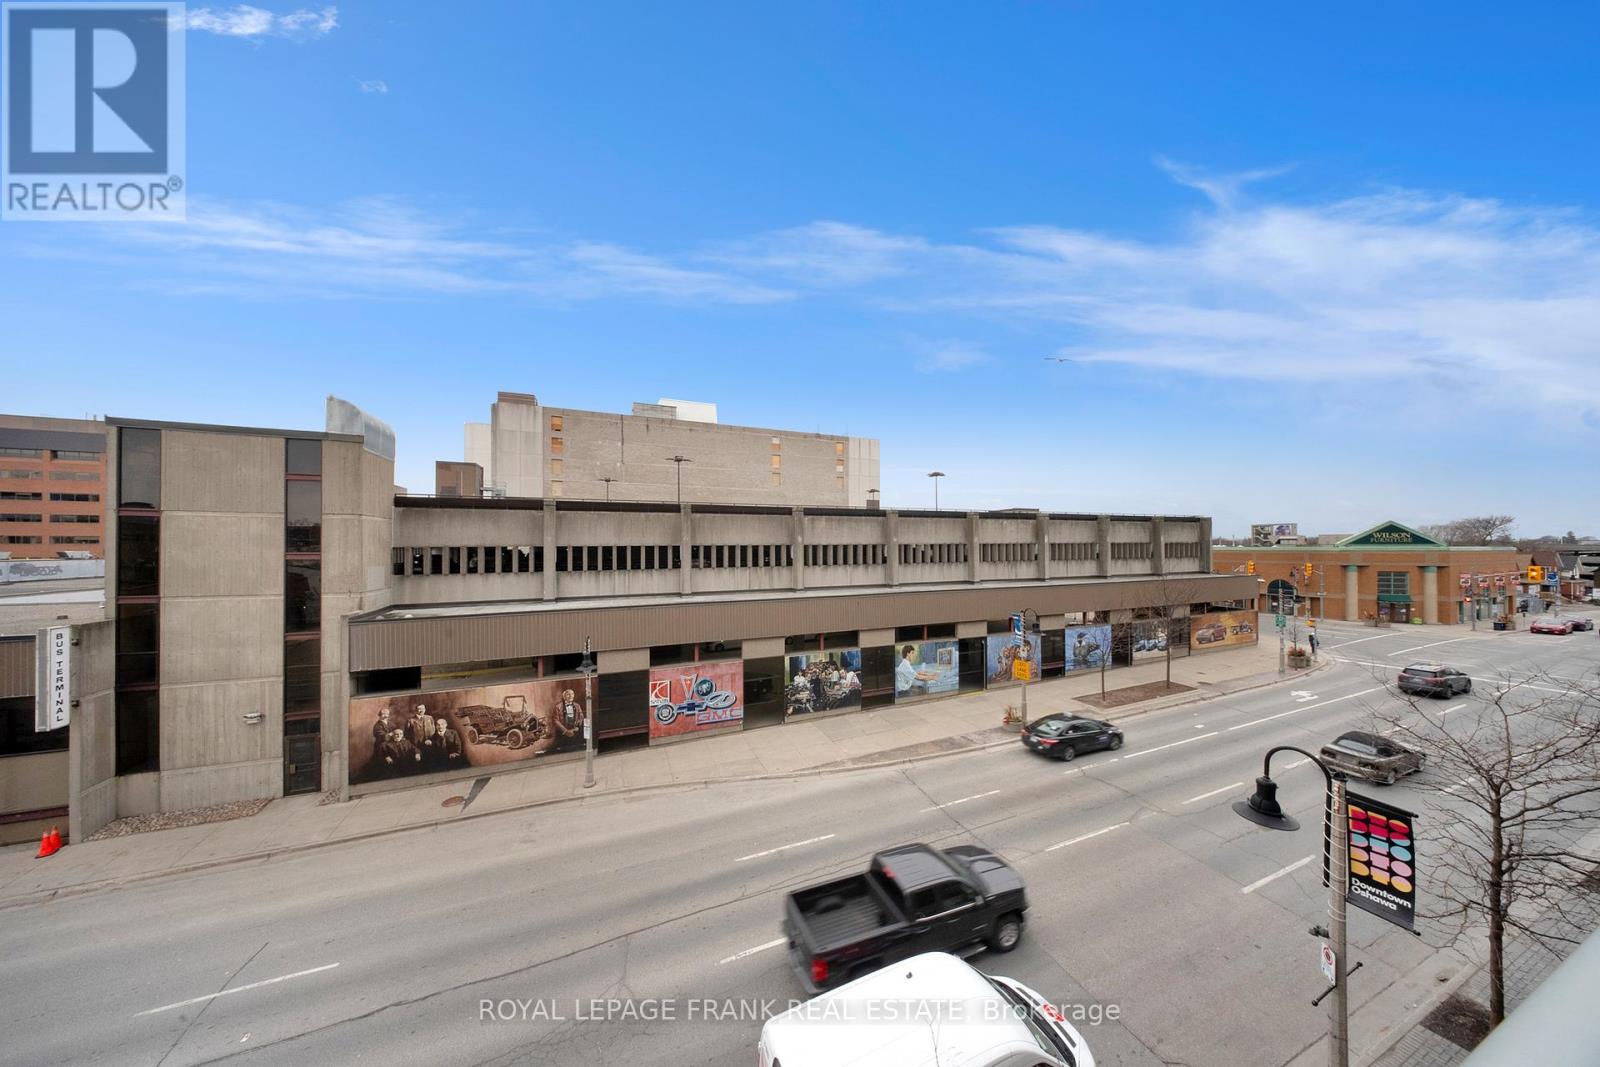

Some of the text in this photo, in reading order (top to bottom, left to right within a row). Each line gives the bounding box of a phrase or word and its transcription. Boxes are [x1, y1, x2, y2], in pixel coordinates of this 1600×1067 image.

[55, 661, 64, 721] TERMINAL
[696, 708, 742, 721] GMC
[1351, 877, 1412, 908] Downtown
[1351, 886, 1397, 910] Oshawa
